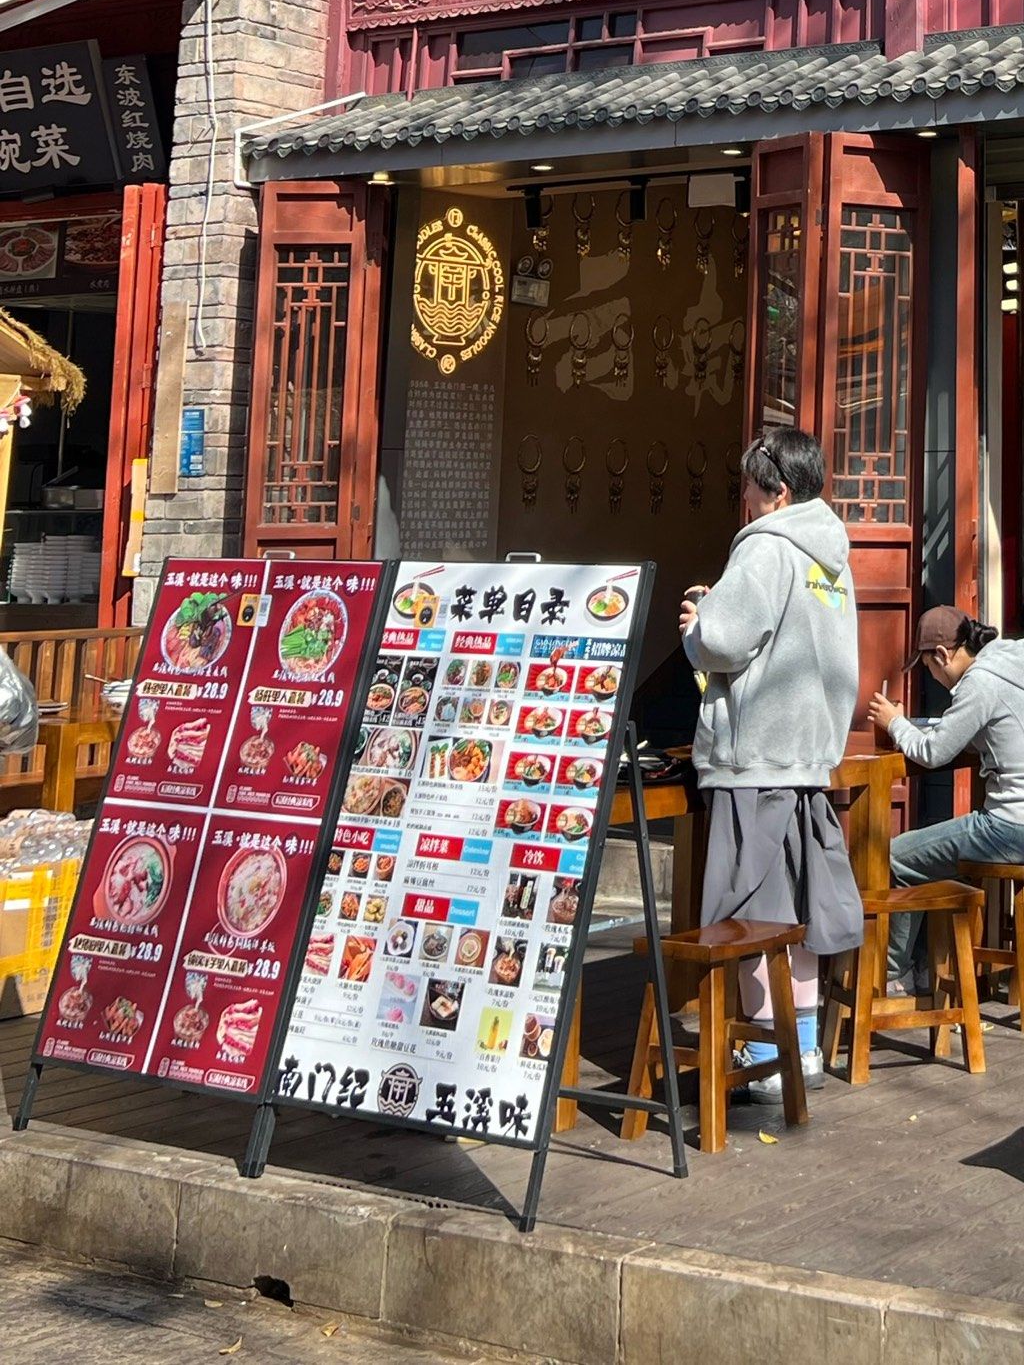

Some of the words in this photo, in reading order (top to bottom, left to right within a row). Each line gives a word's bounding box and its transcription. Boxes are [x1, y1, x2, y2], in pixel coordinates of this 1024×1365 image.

[0, 61, 92, 113] 自选
[114, 64, 155, 173] 东波红烧肉
[450, 584, 570, 625] 菜单目录
